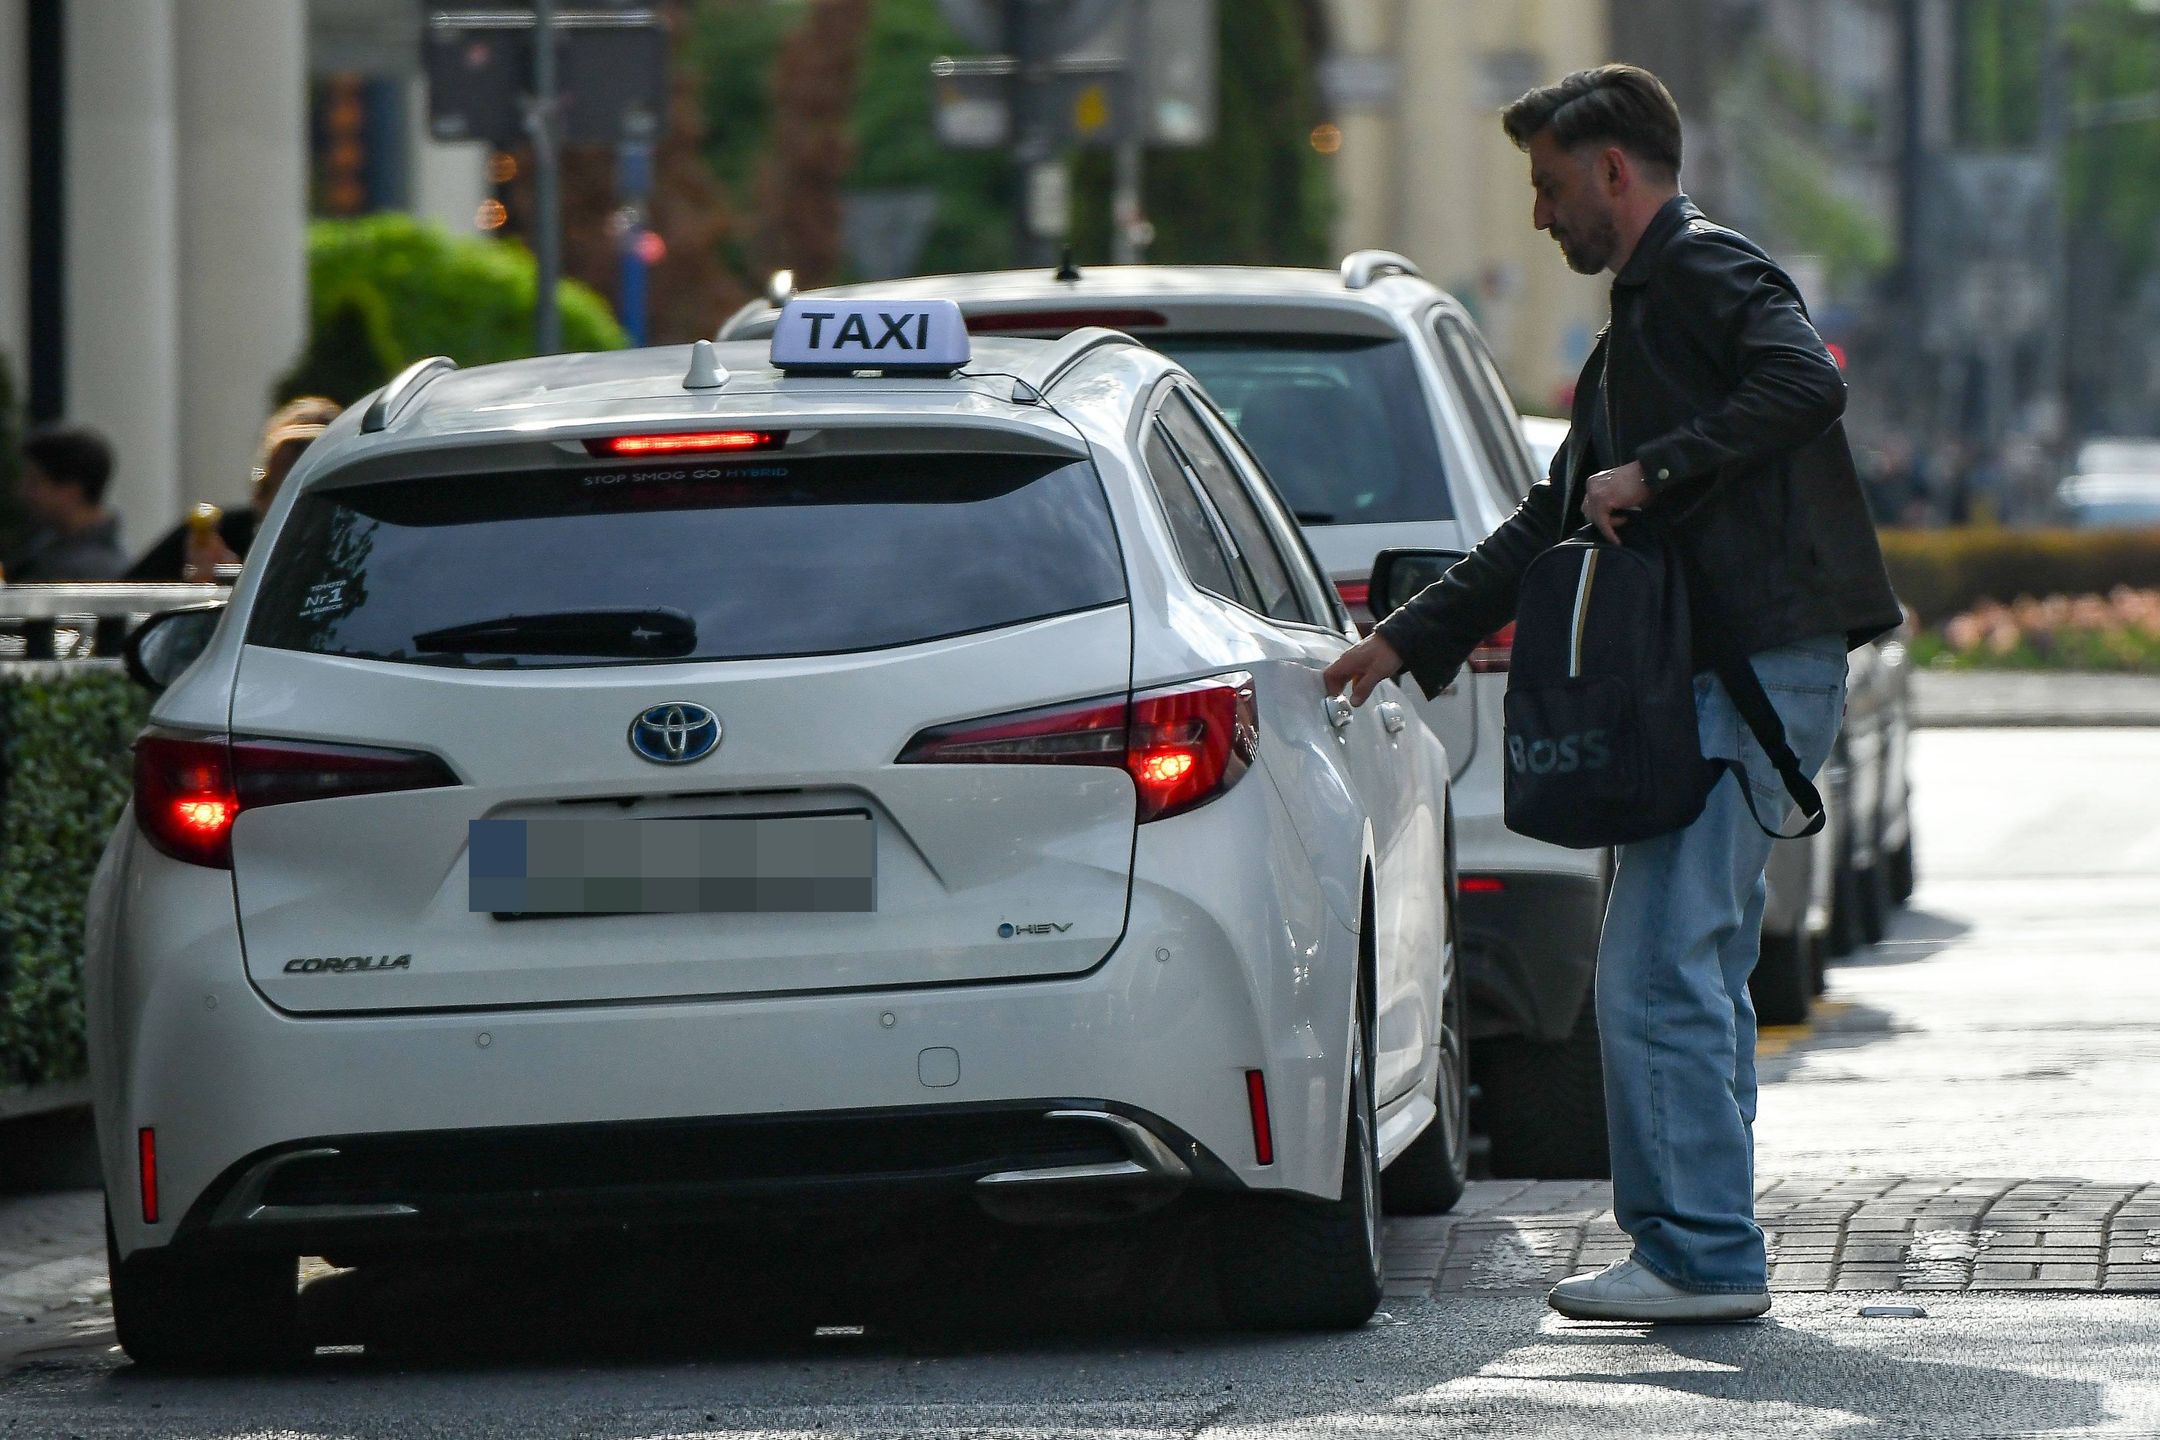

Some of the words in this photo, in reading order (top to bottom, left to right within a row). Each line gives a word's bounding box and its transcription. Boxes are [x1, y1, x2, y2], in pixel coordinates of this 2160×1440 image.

[801, 312, 930, 350] TAXI
[583, 473, 627, 486] STOP
[632, 470, 686, 482] SMOG
[692, 469, 721, 479] GO
[726, 467, 790, 478] HYBRID
[1509, 730, 1610, 774] BOSS
[1016, 922, 1073, 935] HEV
[283, 954, 412, 973] COROLLA
